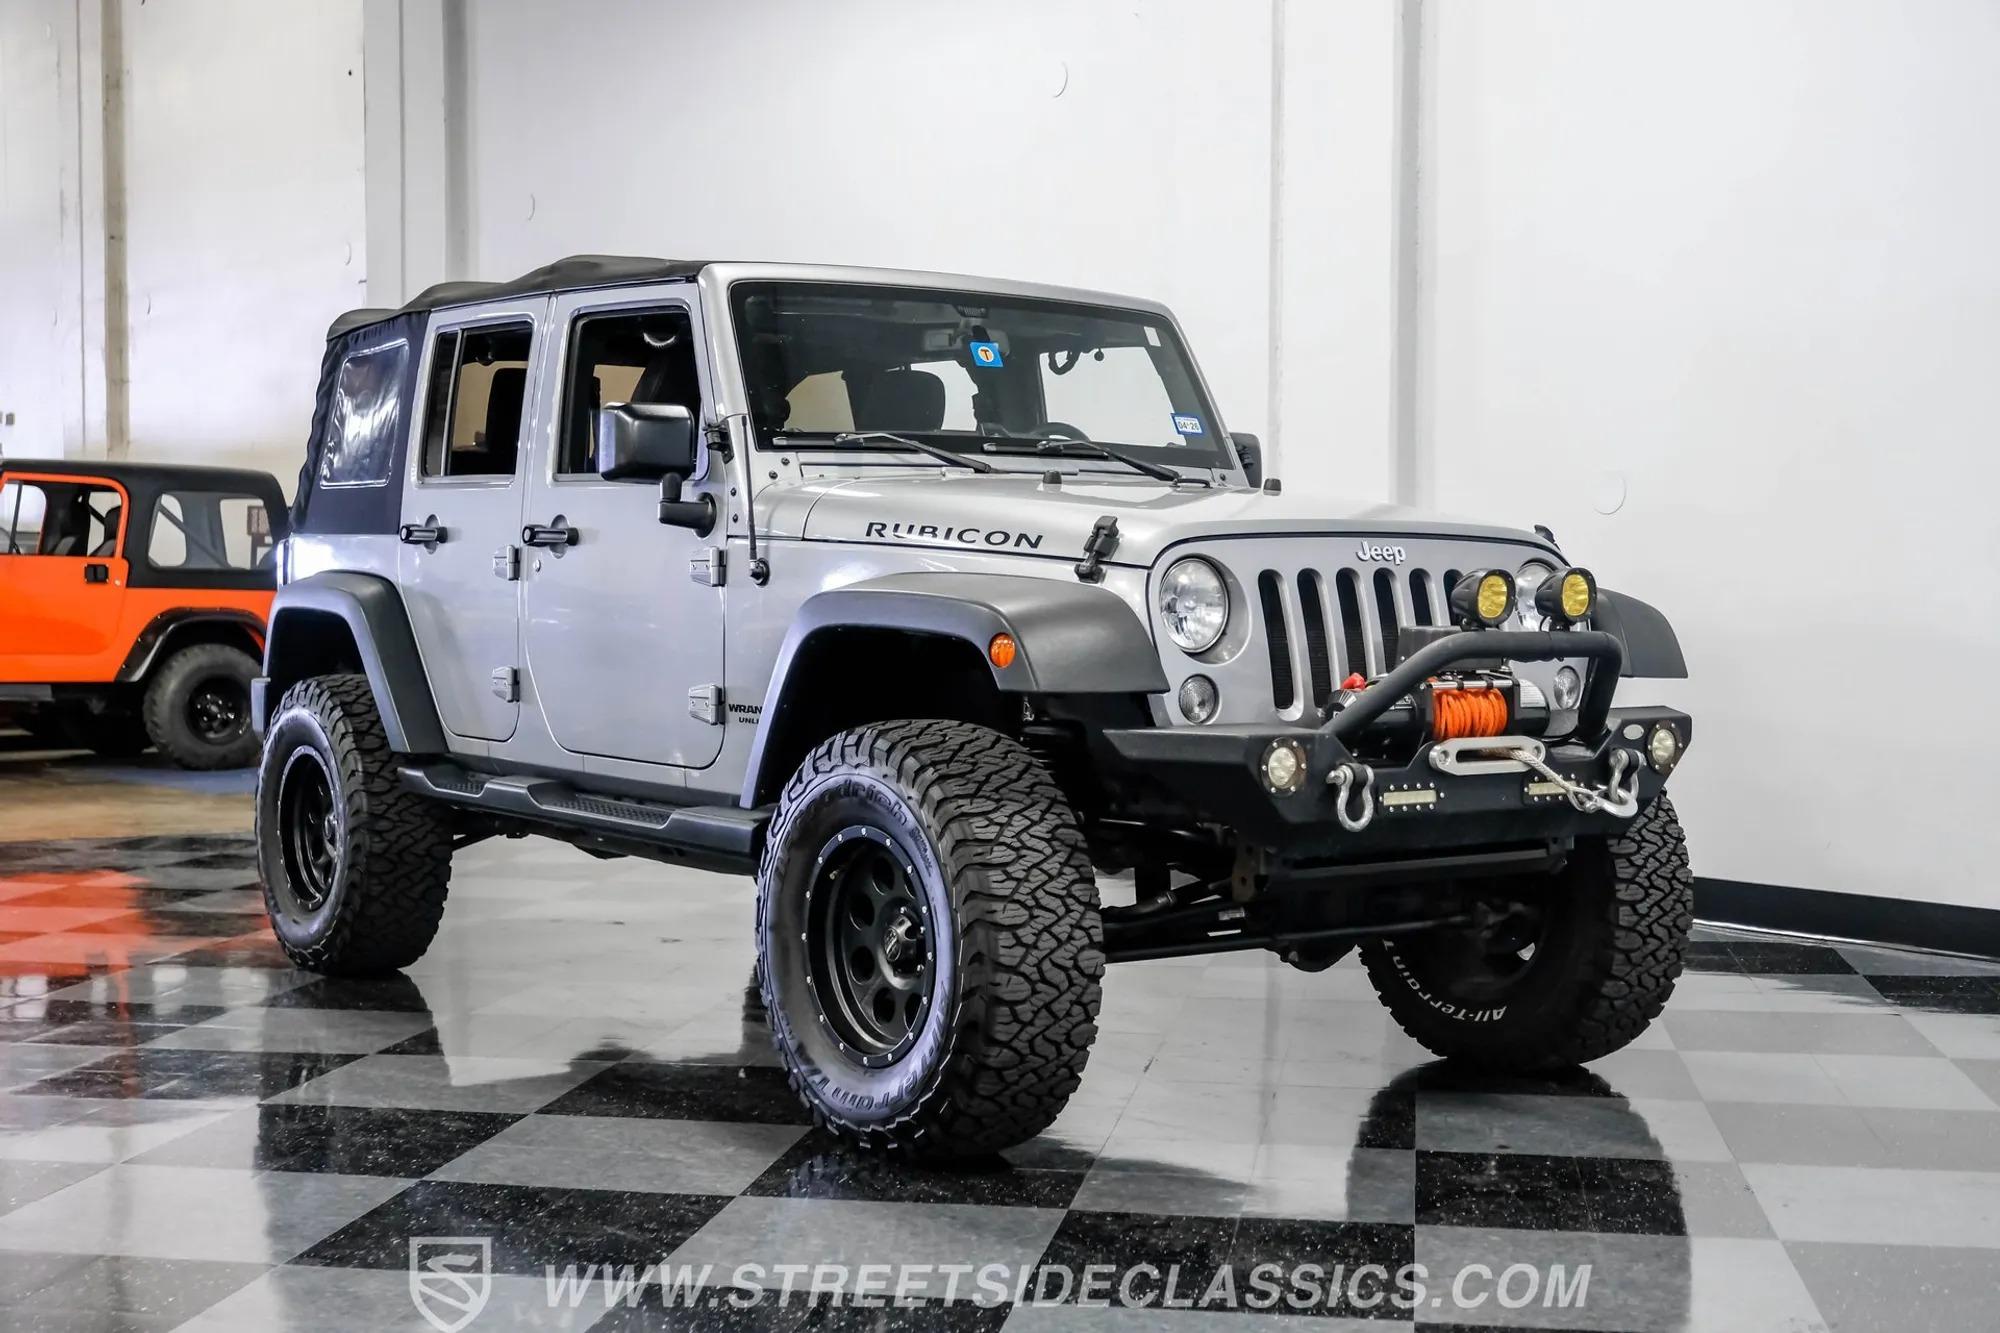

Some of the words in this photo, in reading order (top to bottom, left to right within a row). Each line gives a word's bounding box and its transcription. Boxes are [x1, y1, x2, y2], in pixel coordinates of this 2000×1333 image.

[865, 522, 1043, 549] RUBICON
[1356, 540, 1407, 566] Jeep
[728, 703, 763, 715] WRAN
